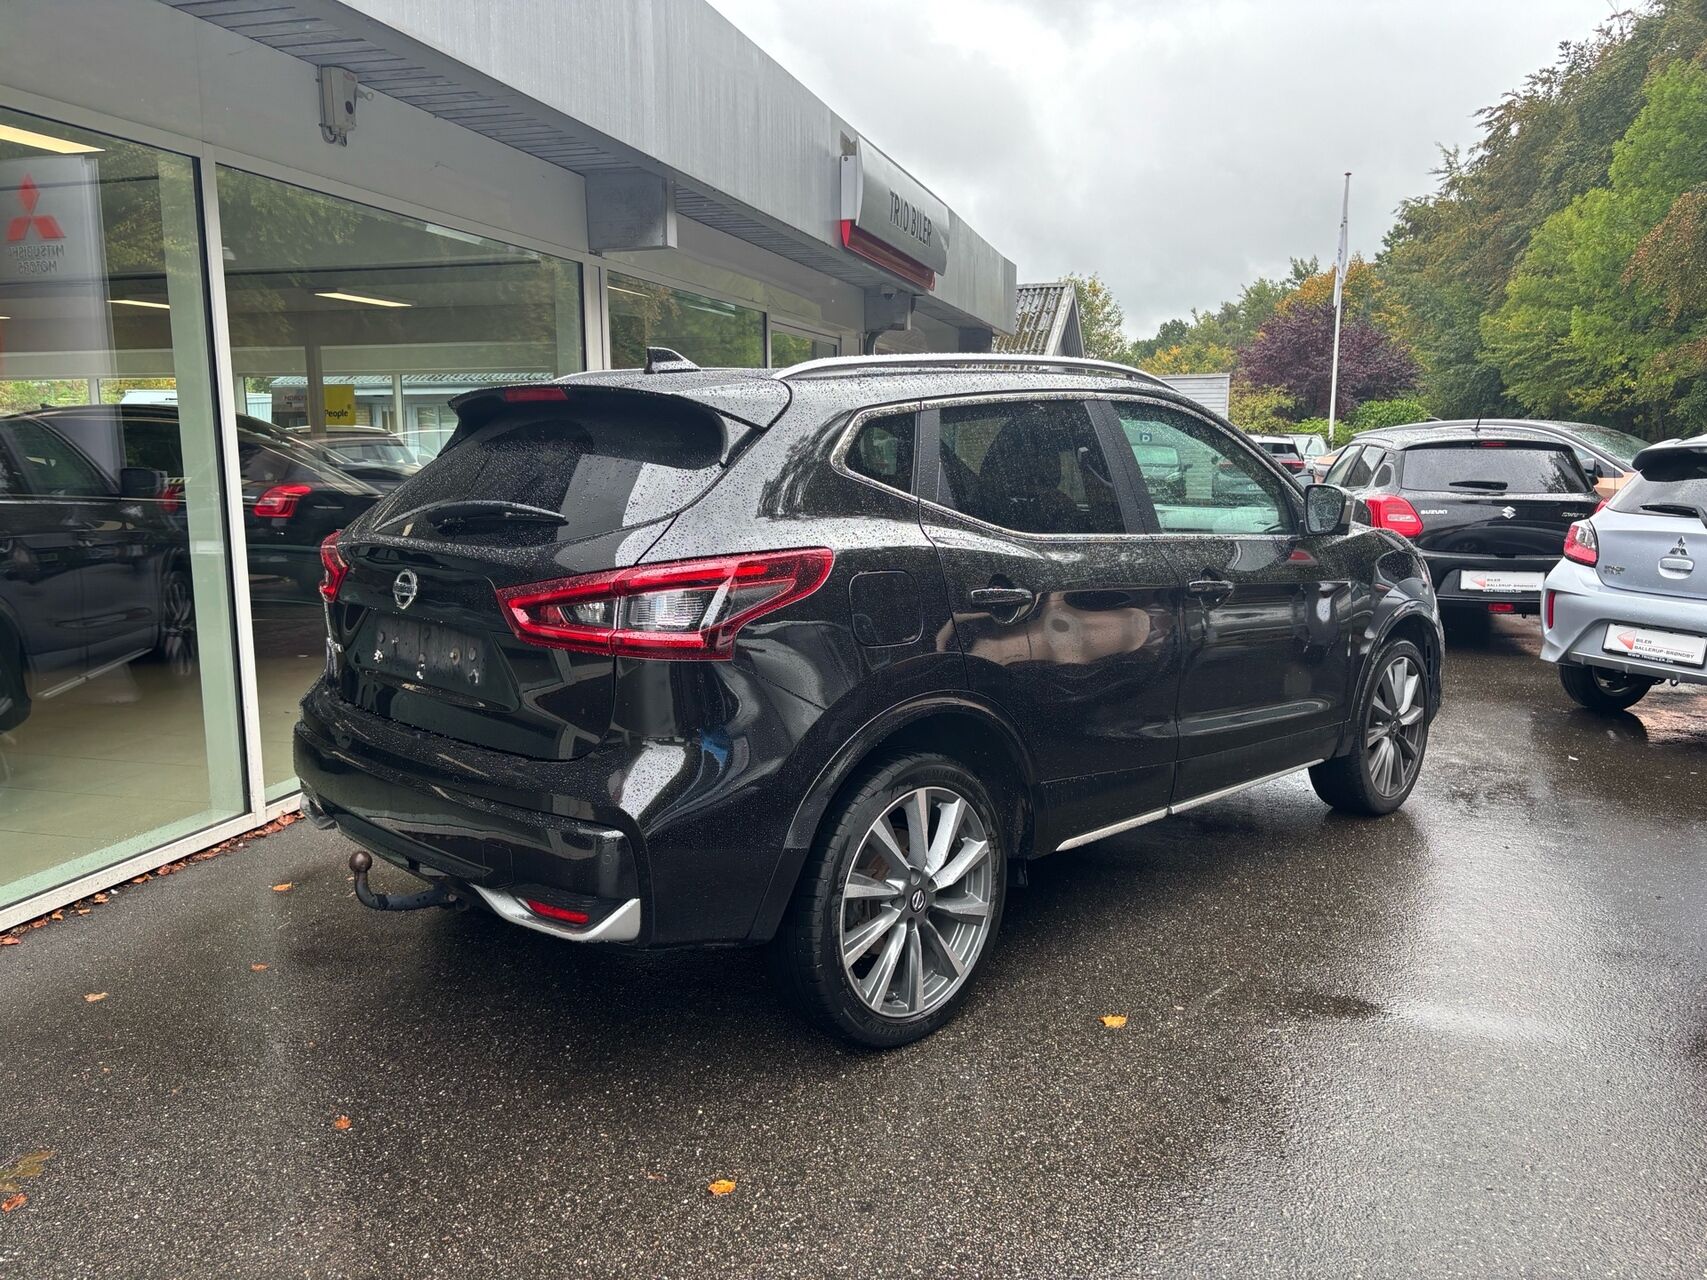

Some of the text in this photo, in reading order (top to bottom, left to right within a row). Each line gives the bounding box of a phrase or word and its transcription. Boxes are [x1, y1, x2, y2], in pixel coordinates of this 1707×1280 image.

[889, 190, 932, 247] TRIO BILER
[324, 408, 349, 419] People
